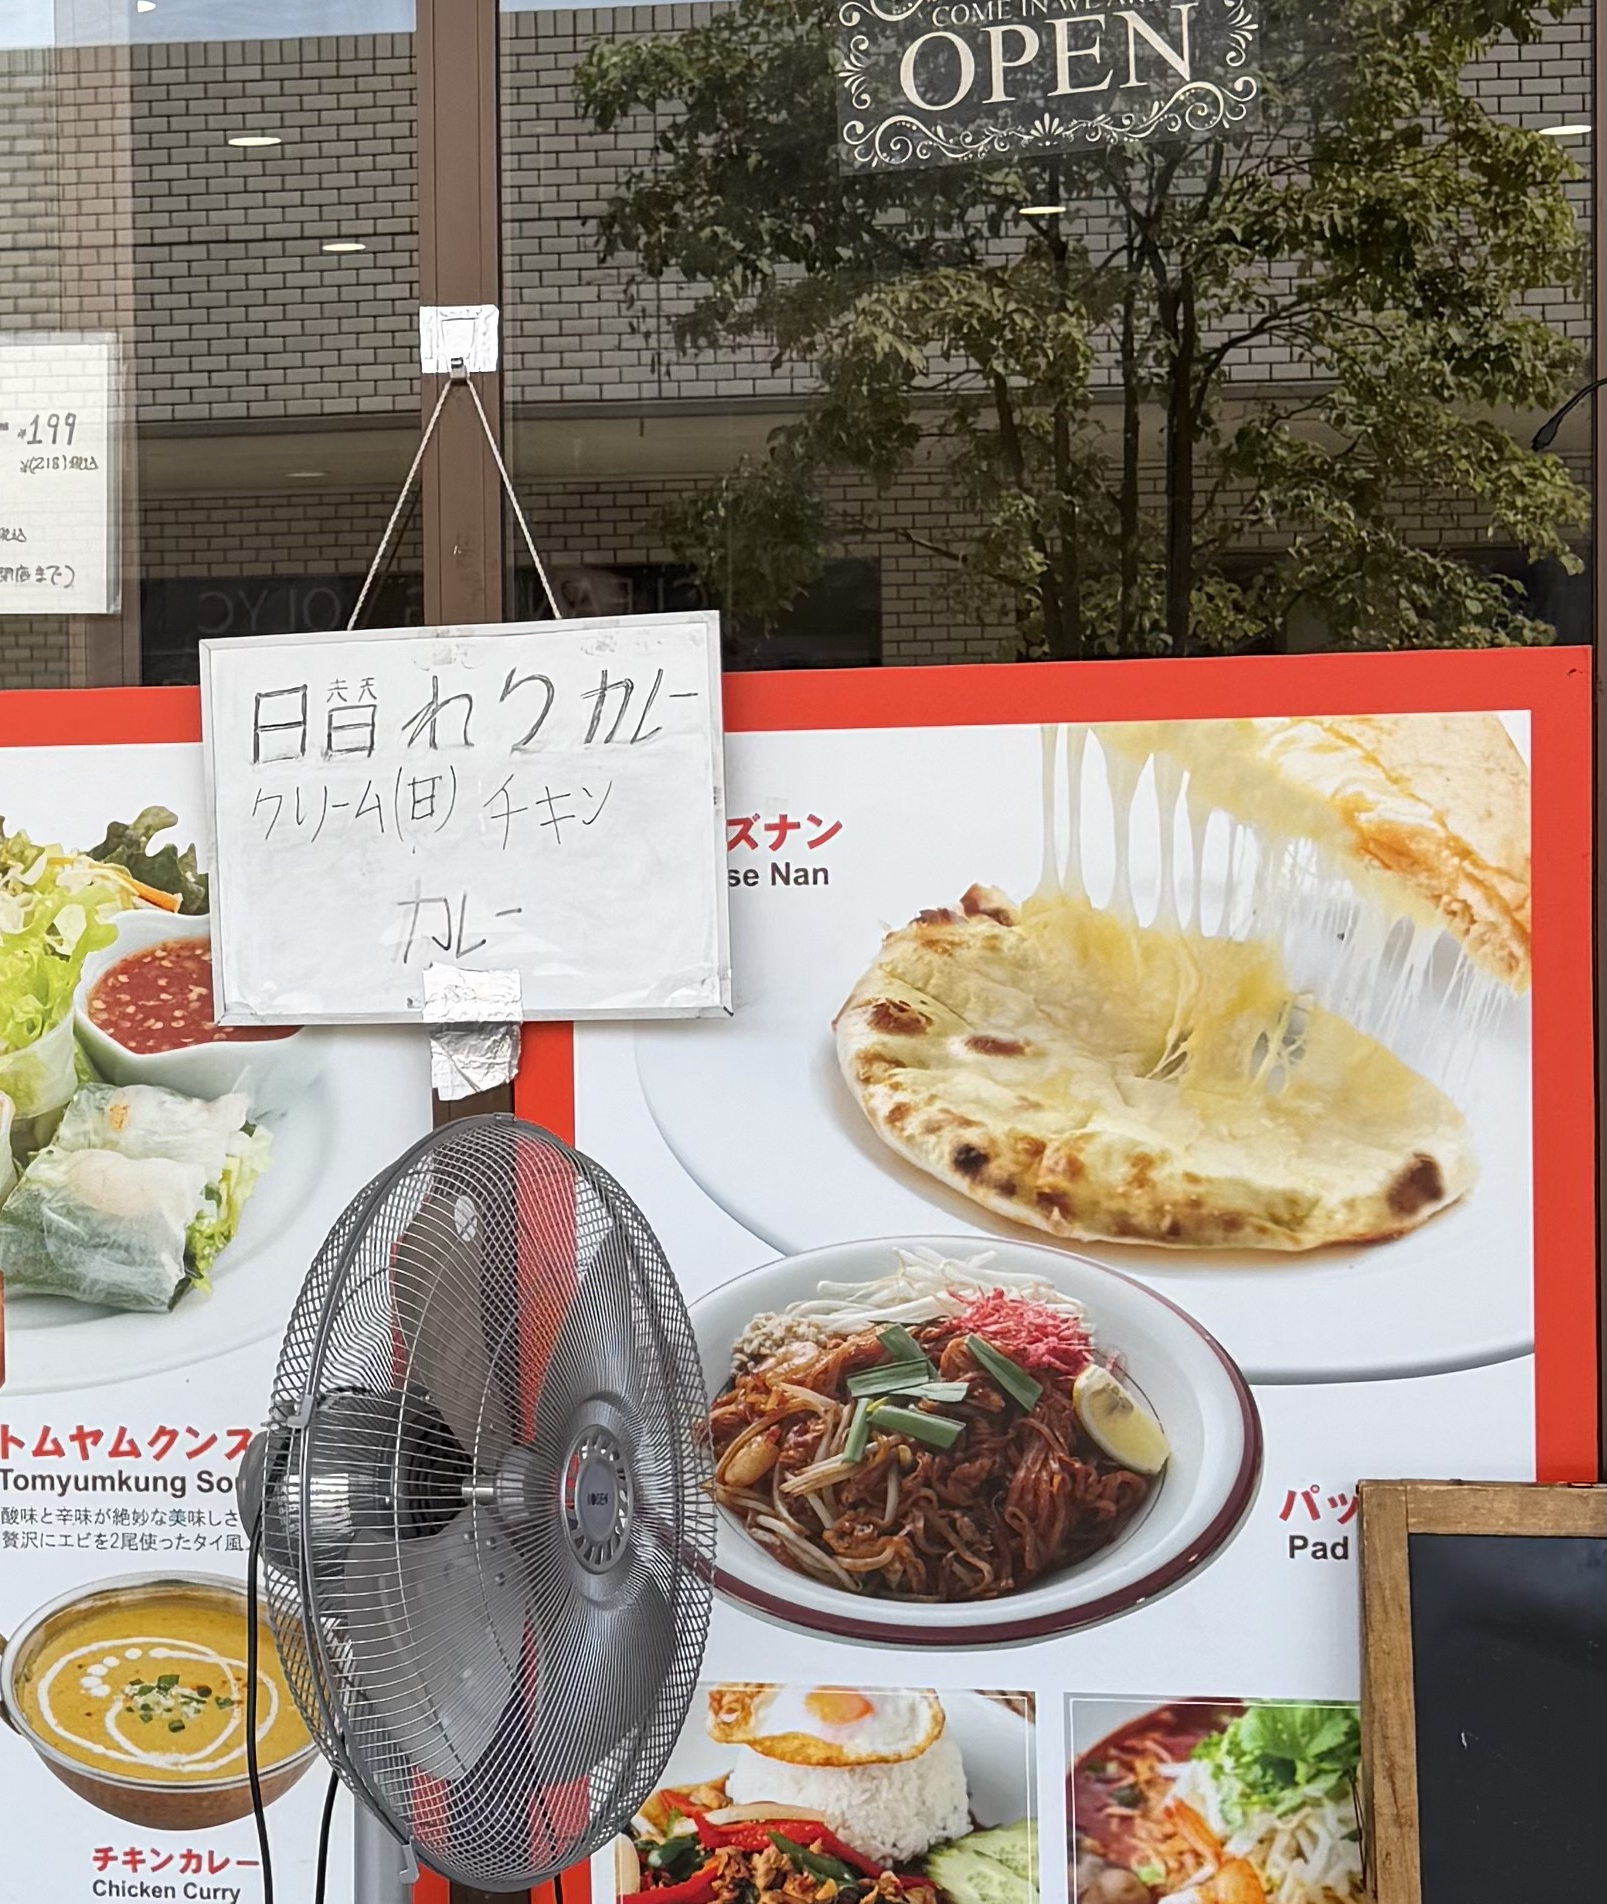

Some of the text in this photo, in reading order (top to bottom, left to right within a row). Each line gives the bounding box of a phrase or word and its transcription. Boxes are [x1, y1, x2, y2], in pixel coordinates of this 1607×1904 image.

[899, 2, 1200, 112] OPEN
[727, 861, 829, 887] se Nan
[395, 876, 522, 965] カレー
[0, 1424, 254, 1462] トムヤムクンス
[196, 1470, 234, 1494] So
[1, 1531, 252, 1552] 贅沢にエビを2尾使ったタイ風
[1288, 1534, 1349, 1560] Pad
[92, 1845, 260, 1875] チキンカレー
[92, 1879, 176, 1900] Chicken
